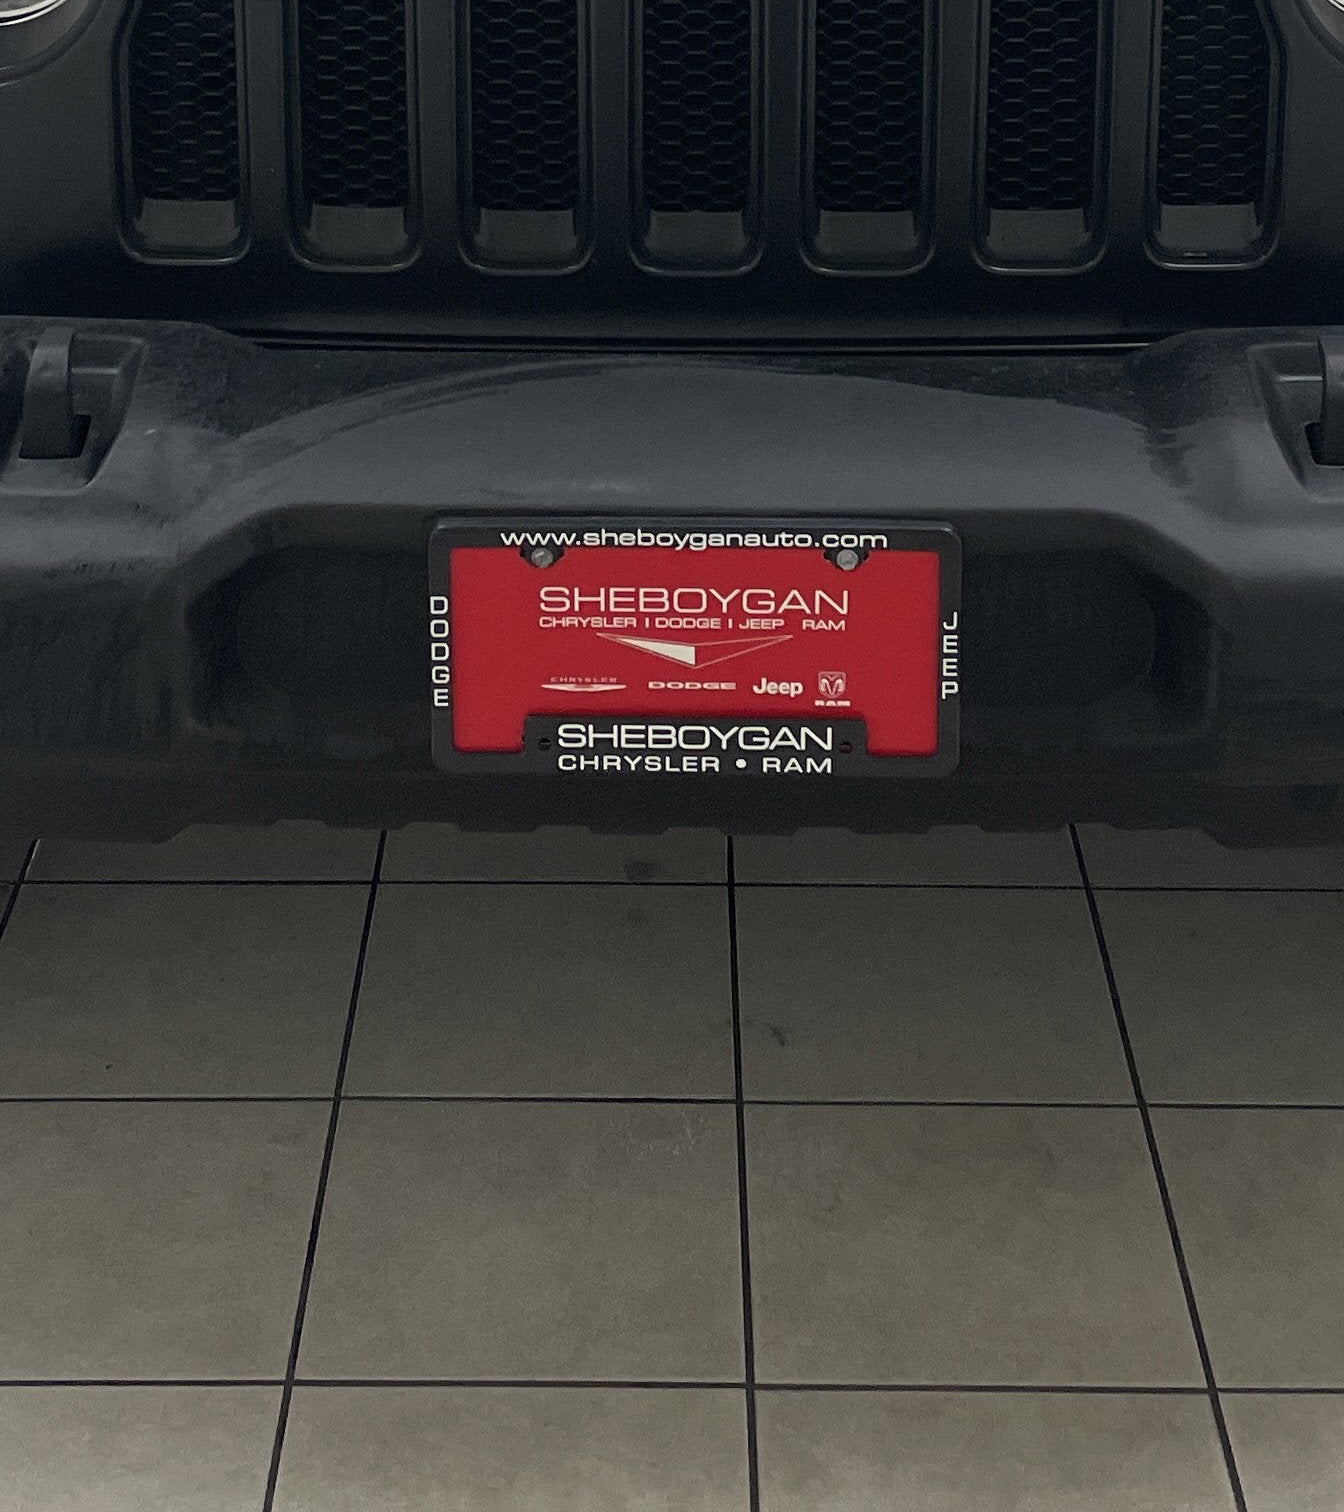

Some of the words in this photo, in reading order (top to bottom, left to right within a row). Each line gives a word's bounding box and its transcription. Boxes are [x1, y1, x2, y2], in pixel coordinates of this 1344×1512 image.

[500, 528, 888, 551] www.sheboyganauto.com
[539, 586, 849, 615] SHEBOYGAN
[539, 616, 637, 628] CHRYSLER
[655, 617, 721, 630] DODGE
[739, 618, 785, 630] JEEP
[802, 619, 846, 631] RAM
[429, 595, 450, 707] DODGE
[941, 611, 959, 700] JEEP
[648, 681, 737, 690] DODGE
[752, 677, 804, 698] Jeep
[557, 723, 833, 751] SHEBOYGAN
[557, 754, 720, 773] CHRYSLER
[762, 757, 832, 774] RAM
